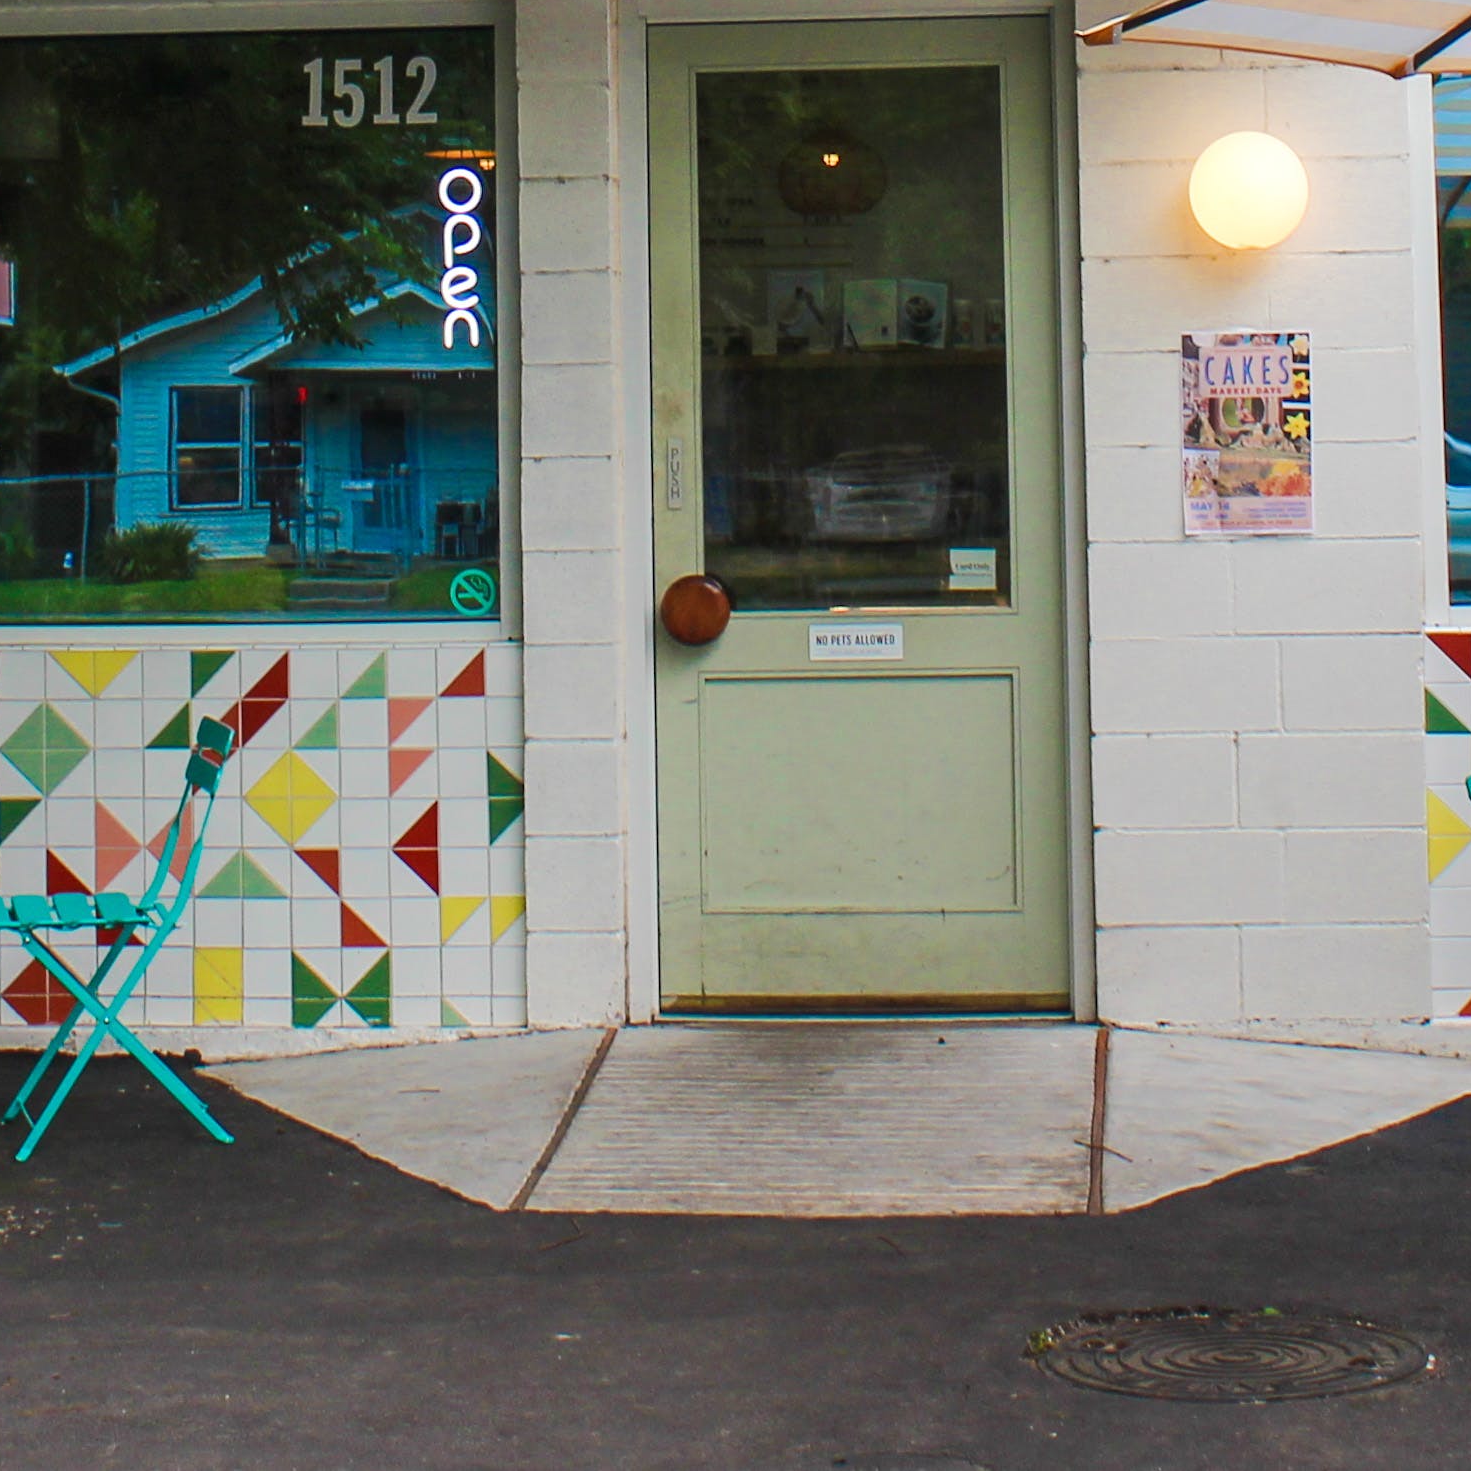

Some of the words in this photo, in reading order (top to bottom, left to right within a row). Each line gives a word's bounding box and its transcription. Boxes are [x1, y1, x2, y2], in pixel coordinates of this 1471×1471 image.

[301, 55, 438, 128] 1512
[1204, 355, 1290, 386] CAKES
[1210, 387, 1251, 395] MARKET
[1255, 387, 1283, 395] DAYS
[670, 447, 680, 499] PUSH
[816, 634, 828, 646] NO
[831, 633, 851, 646] PETS
[854, 633, 895, 645] ALLOWED
